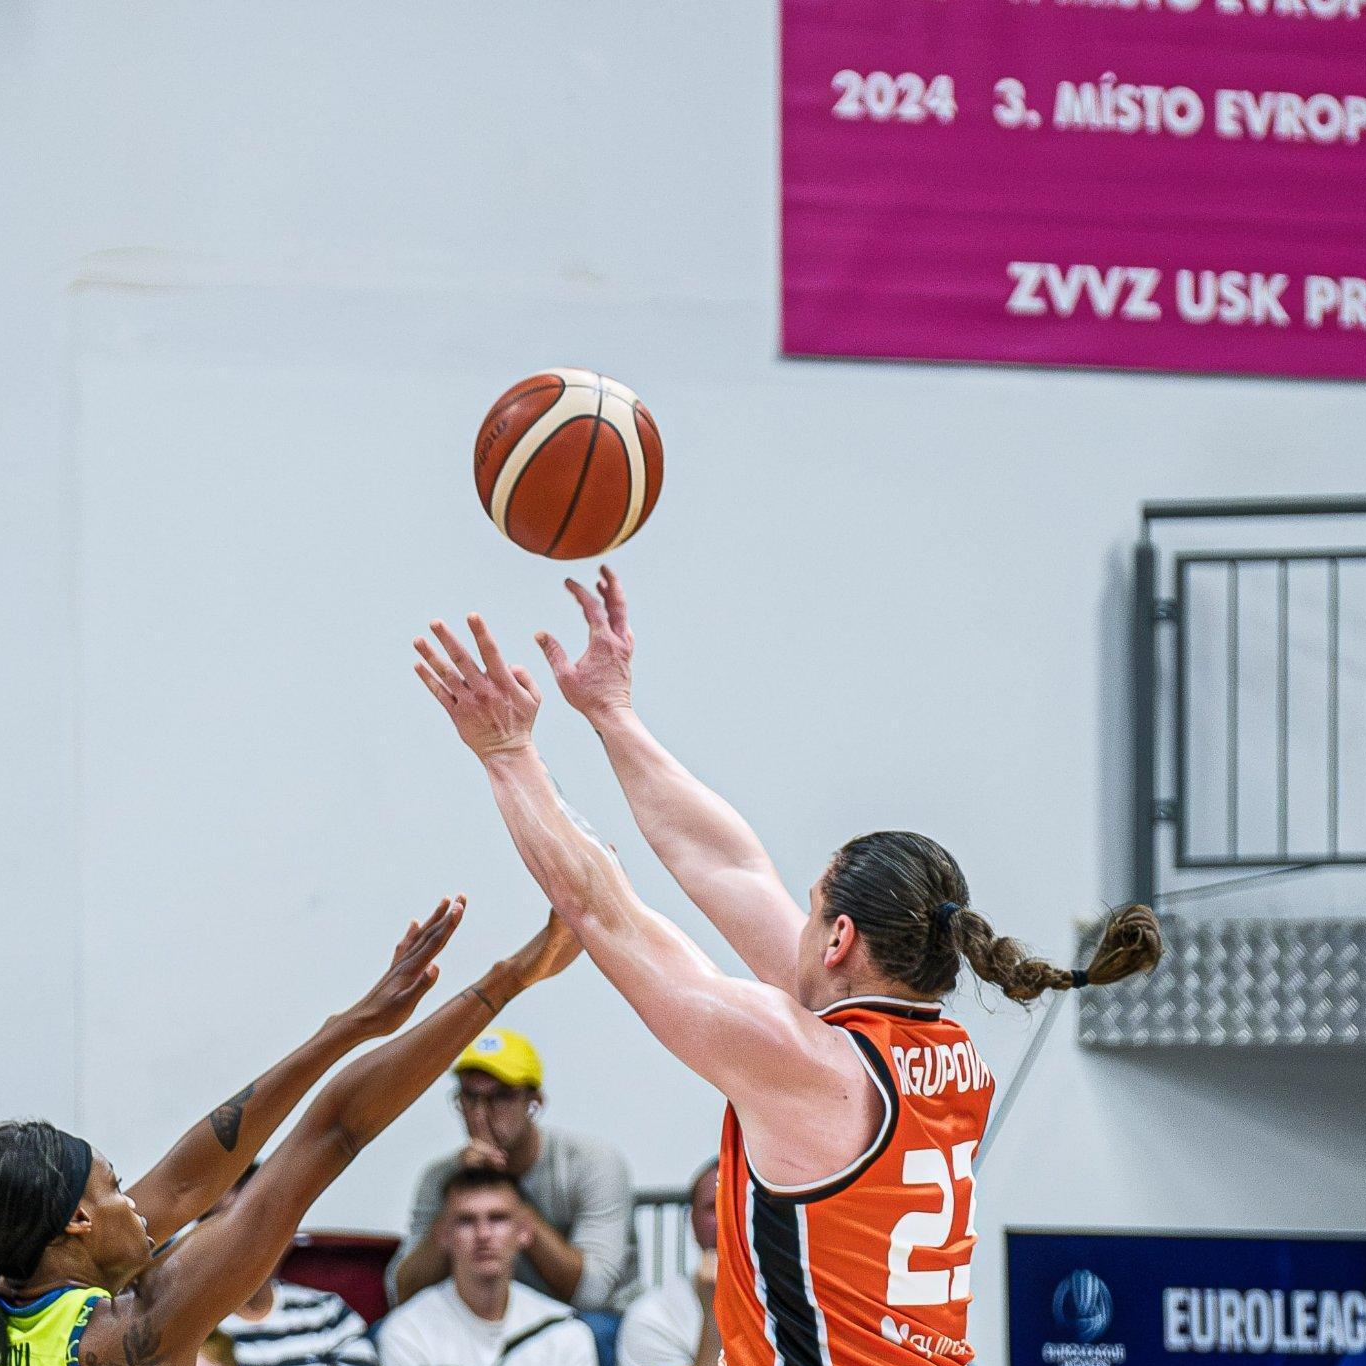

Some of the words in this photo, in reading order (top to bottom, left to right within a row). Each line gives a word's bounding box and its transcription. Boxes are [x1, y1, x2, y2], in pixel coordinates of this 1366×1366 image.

[831, 69, 957, 125] 2024
[992, 77, 1042, 129] 3.
[1053, 71, 1205, 137] MÍSTO
[1007, 261, 1162, 320] ZVVZ
[1176, 269, 1290, 327] USK
